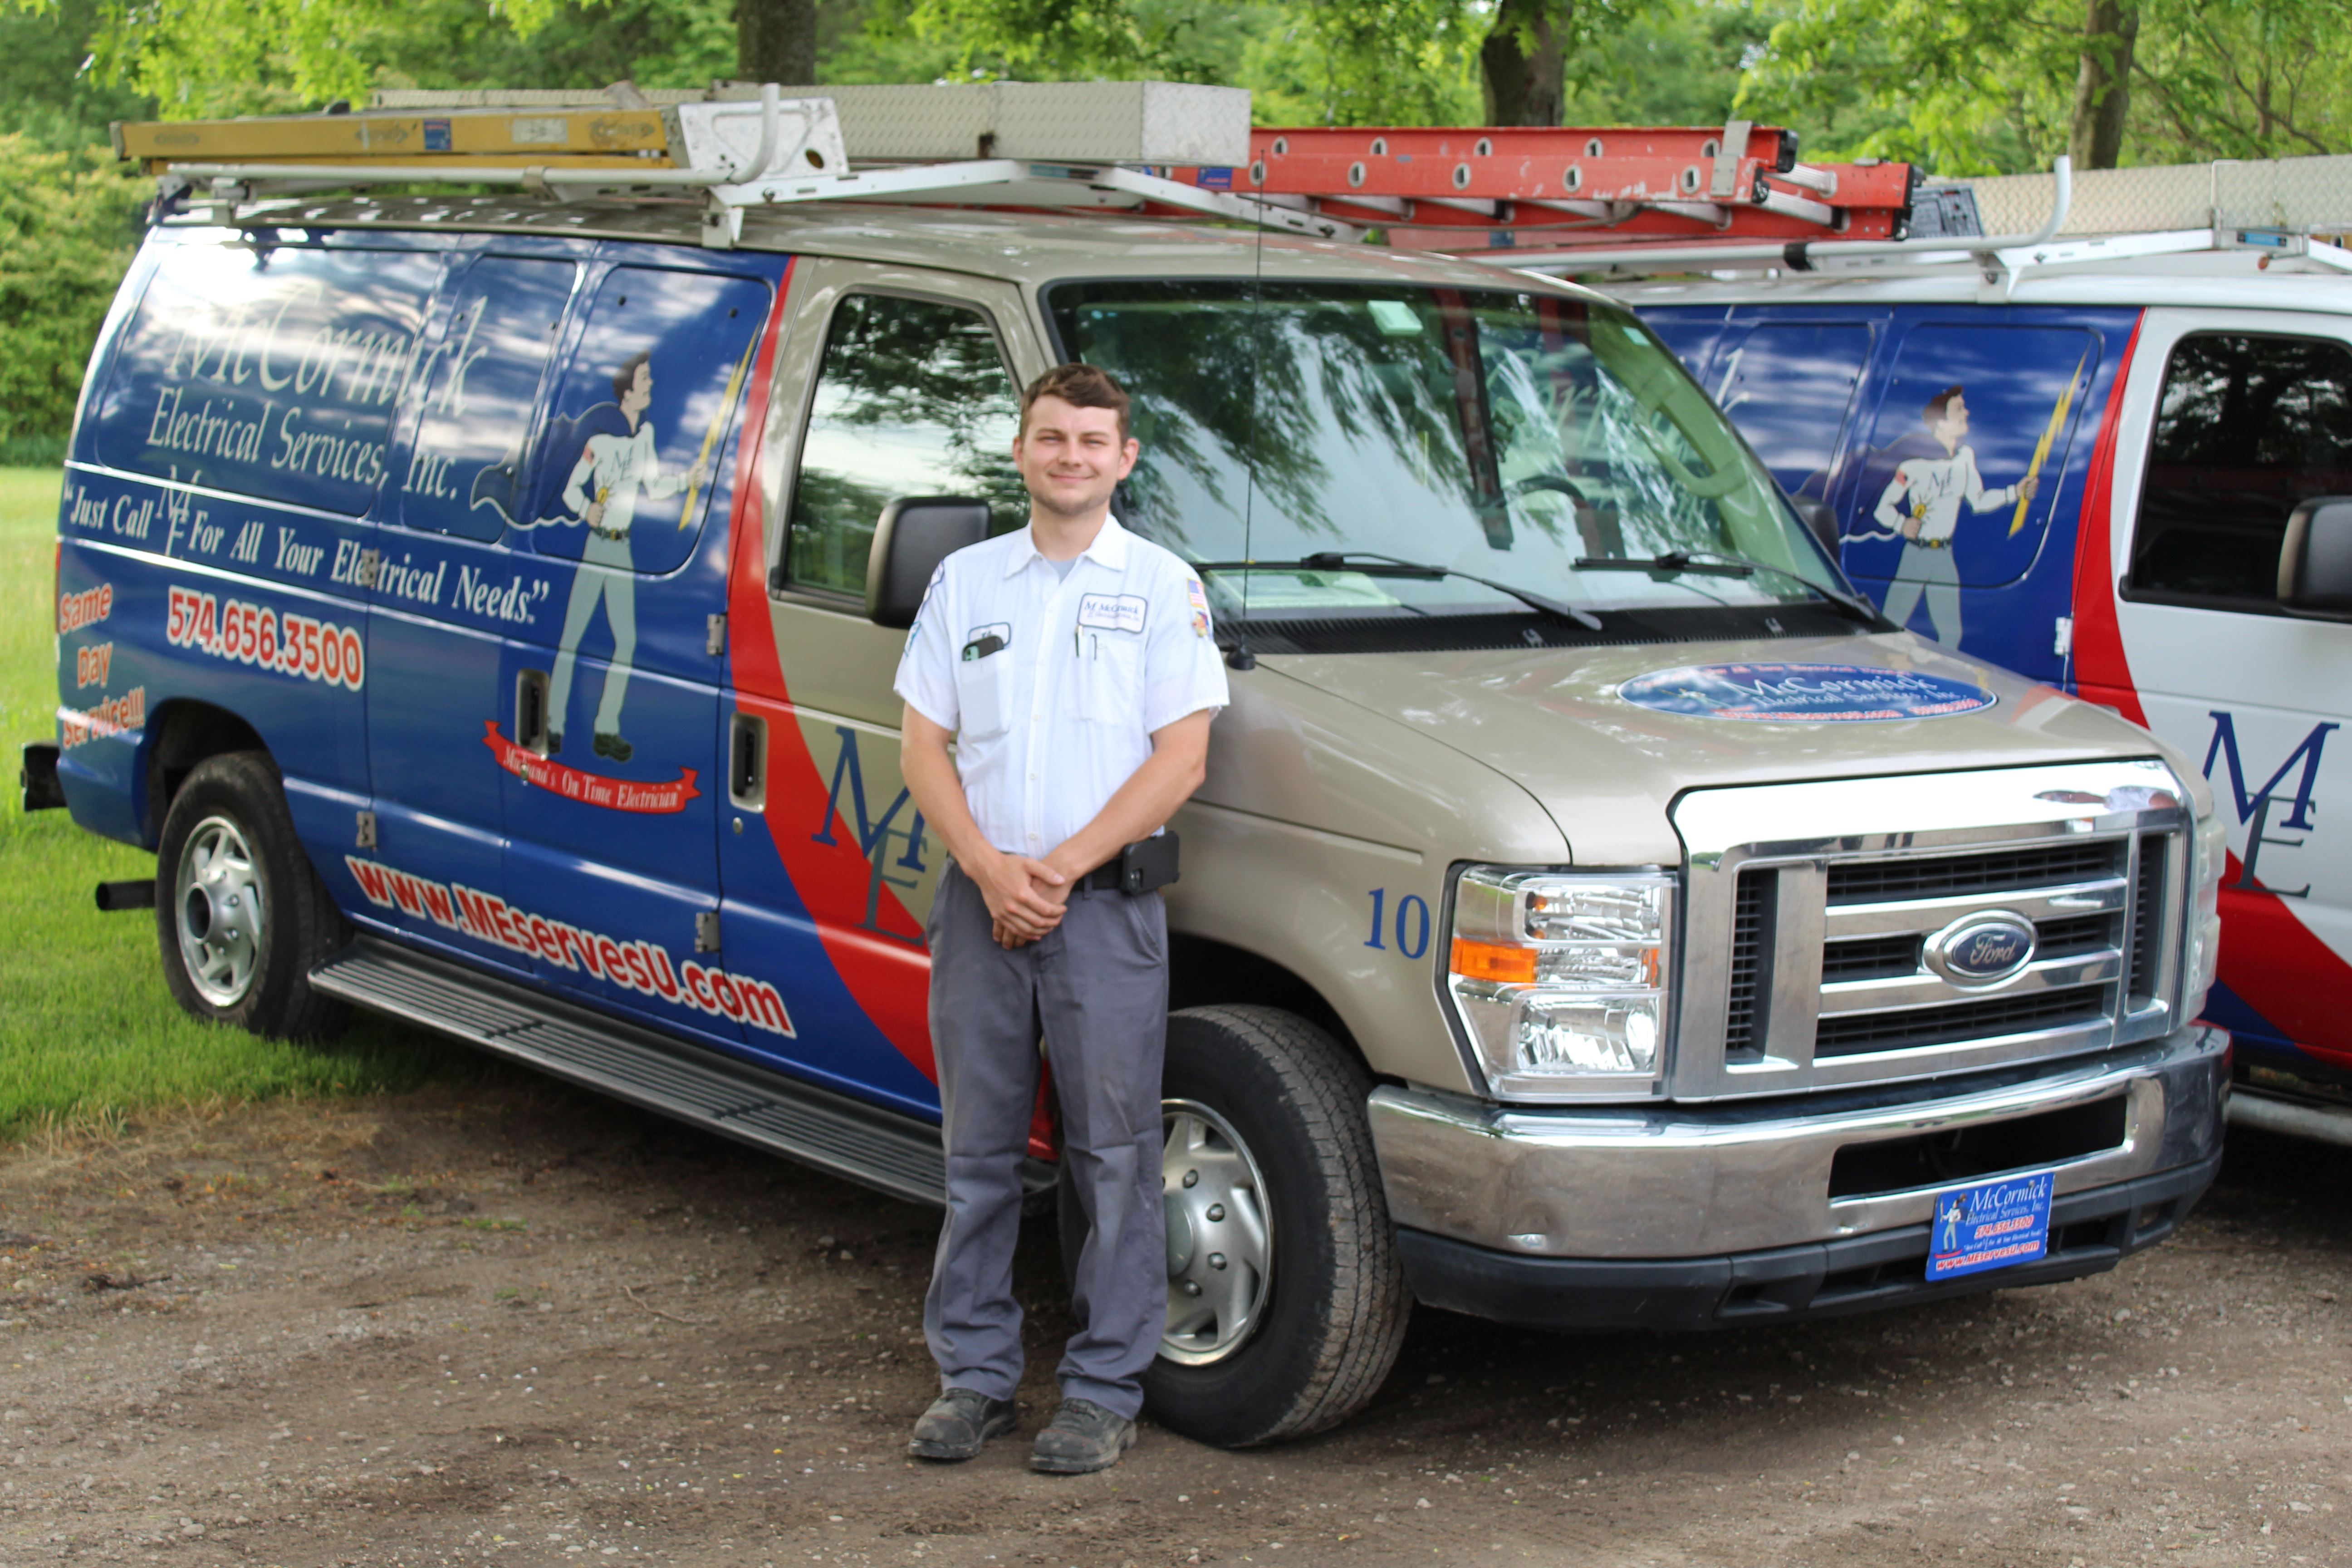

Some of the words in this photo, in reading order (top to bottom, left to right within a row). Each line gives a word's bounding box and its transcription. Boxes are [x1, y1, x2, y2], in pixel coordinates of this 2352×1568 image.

[163, 284, 489, 416] McCormick
[146, 386, 273, 463] Electrical
[271, 407, 389, 491] Services,
[401, 454, 458, 500] Inc.
[113, 494, 155, 540] Call
[188, 510, 225, 555] For
[229, 520, 265, 564] All
[274, 526, 324, 576] Your
[330, 538, 447, 604] Eletrical
[59, 583, 113, 635] Same
[167, 585, 364, 691] 574.656.3500
[77, 642, 113, 690] Day
[1716, 674, 1938, 696] McCormick
[562, 770, 579, 797] On
[1363, 887, 1430, 960] 10
[1970, 932, 2017, 965] Ford
[1965, 1207, 1999, 1227] Electrical
[1970, 1176, 2048, 1212] McCormick
